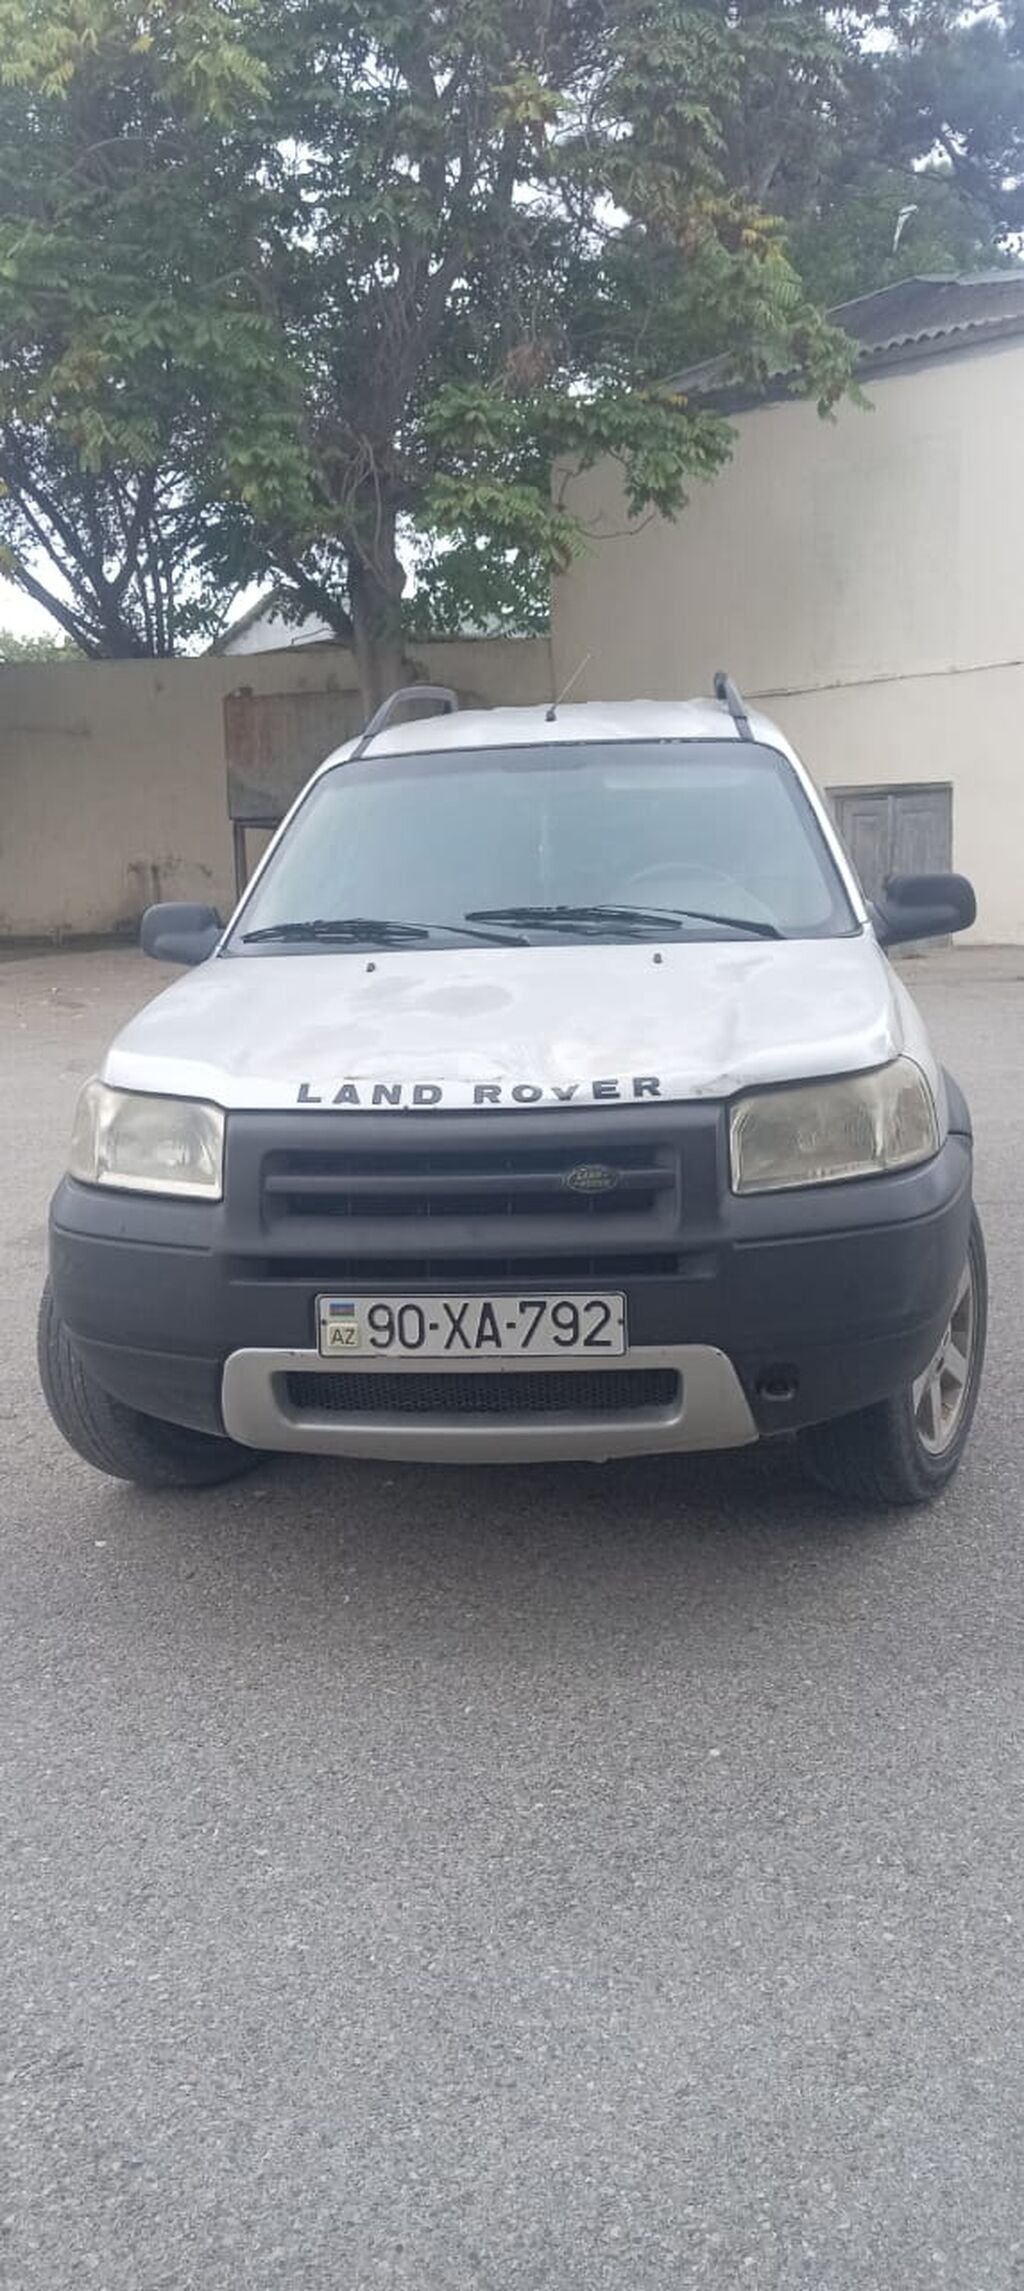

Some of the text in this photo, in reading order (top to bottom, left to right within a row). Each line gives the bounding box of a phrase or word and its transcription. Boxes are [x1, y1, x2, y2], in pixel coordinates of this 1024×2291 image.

[297, 1077, 661, 1105] LAND ROVER
[330, 1328, 356, 1345] AZ
[367, 1301, 612, 1349] 90-XA-792
